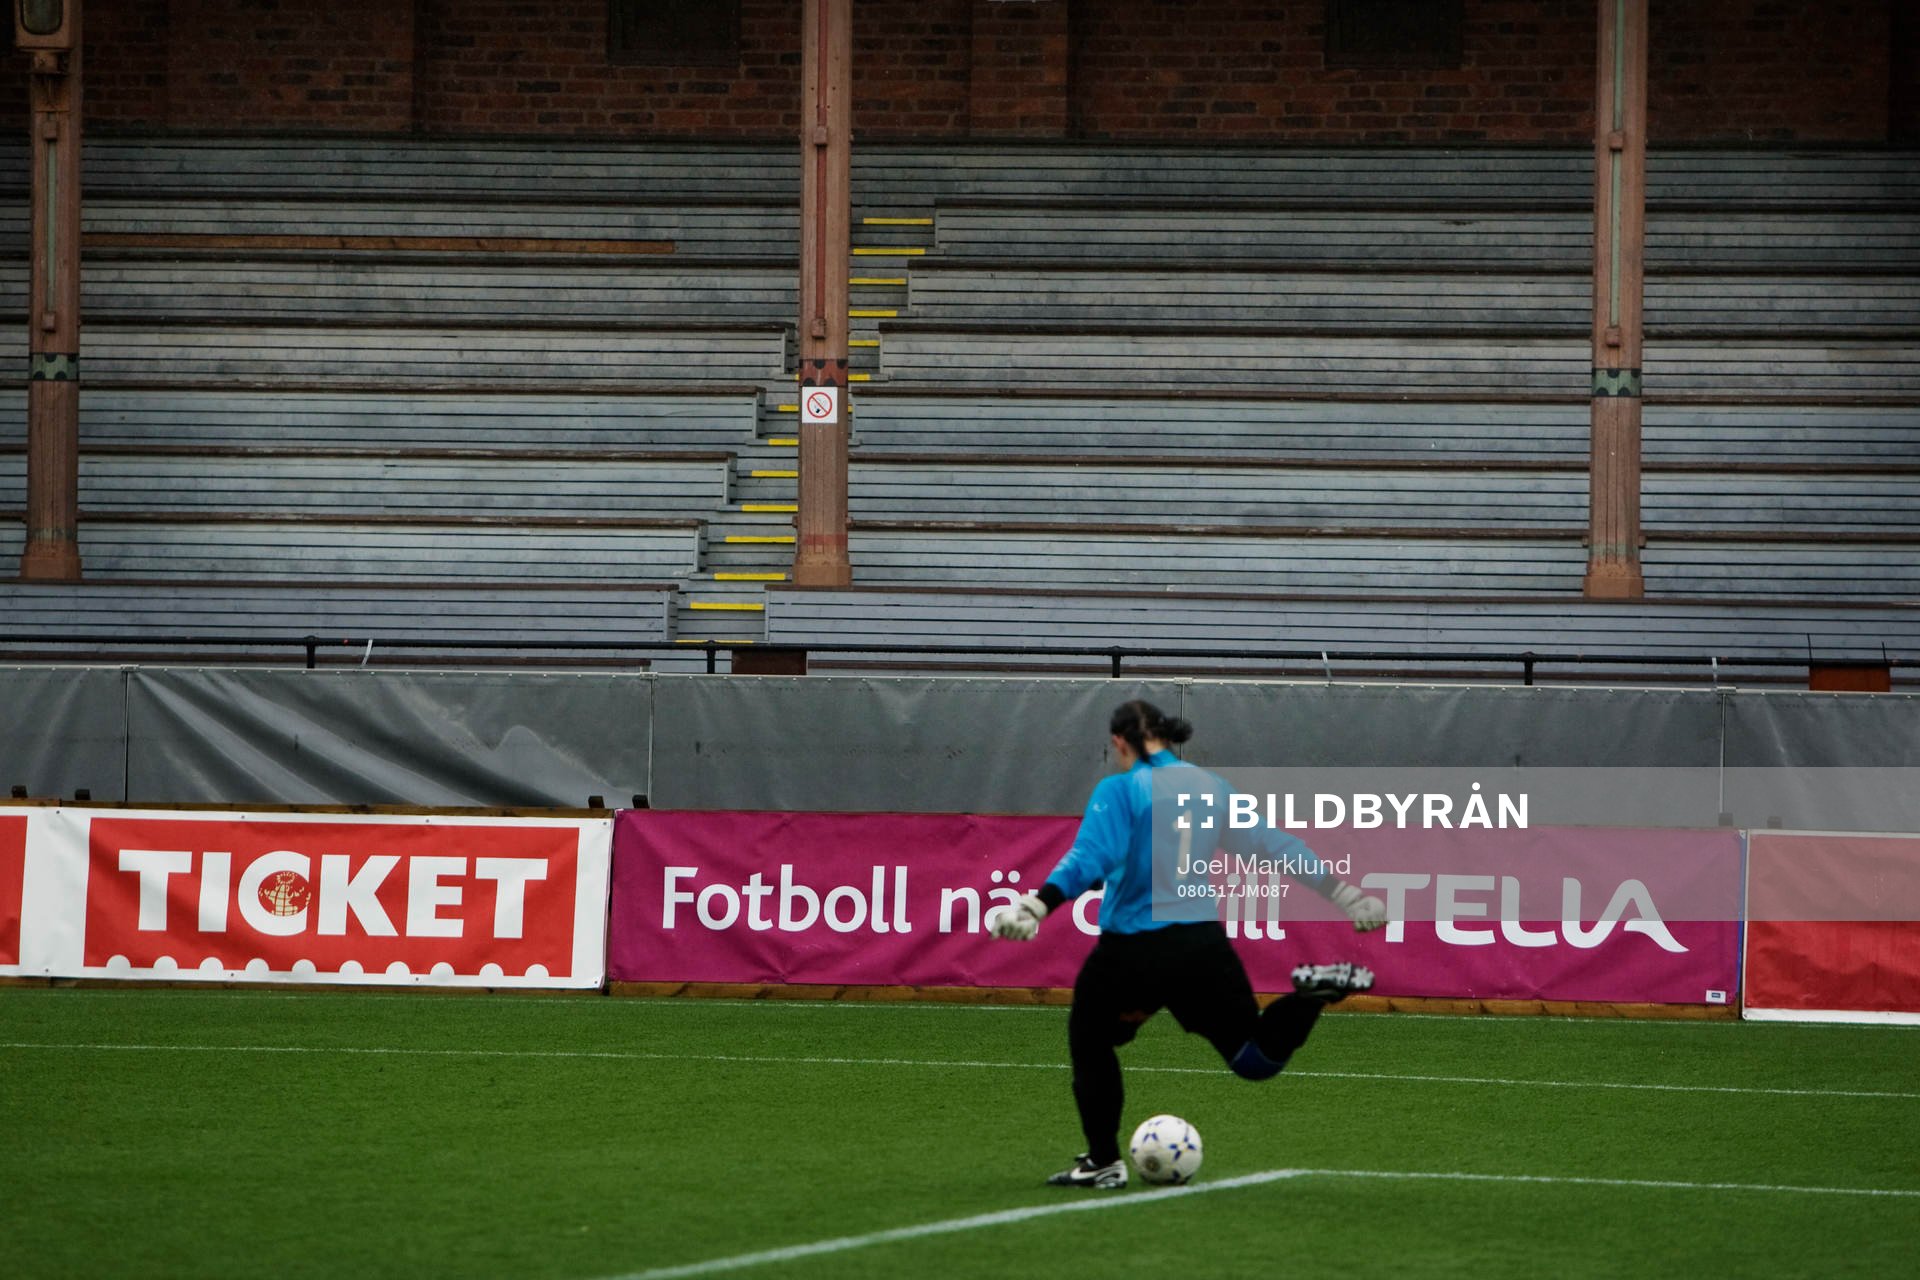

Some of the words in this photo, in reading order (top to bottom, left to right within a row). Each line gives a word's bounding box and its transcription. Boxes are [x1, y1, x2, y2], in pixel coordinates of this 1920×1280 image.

[117, 849, 549, 938] TICKET
[662, 864, 912, 934] Fotboll
[1215, 872, 1287, 941] ill
[1361, 872, 1690, 953] TELIA
